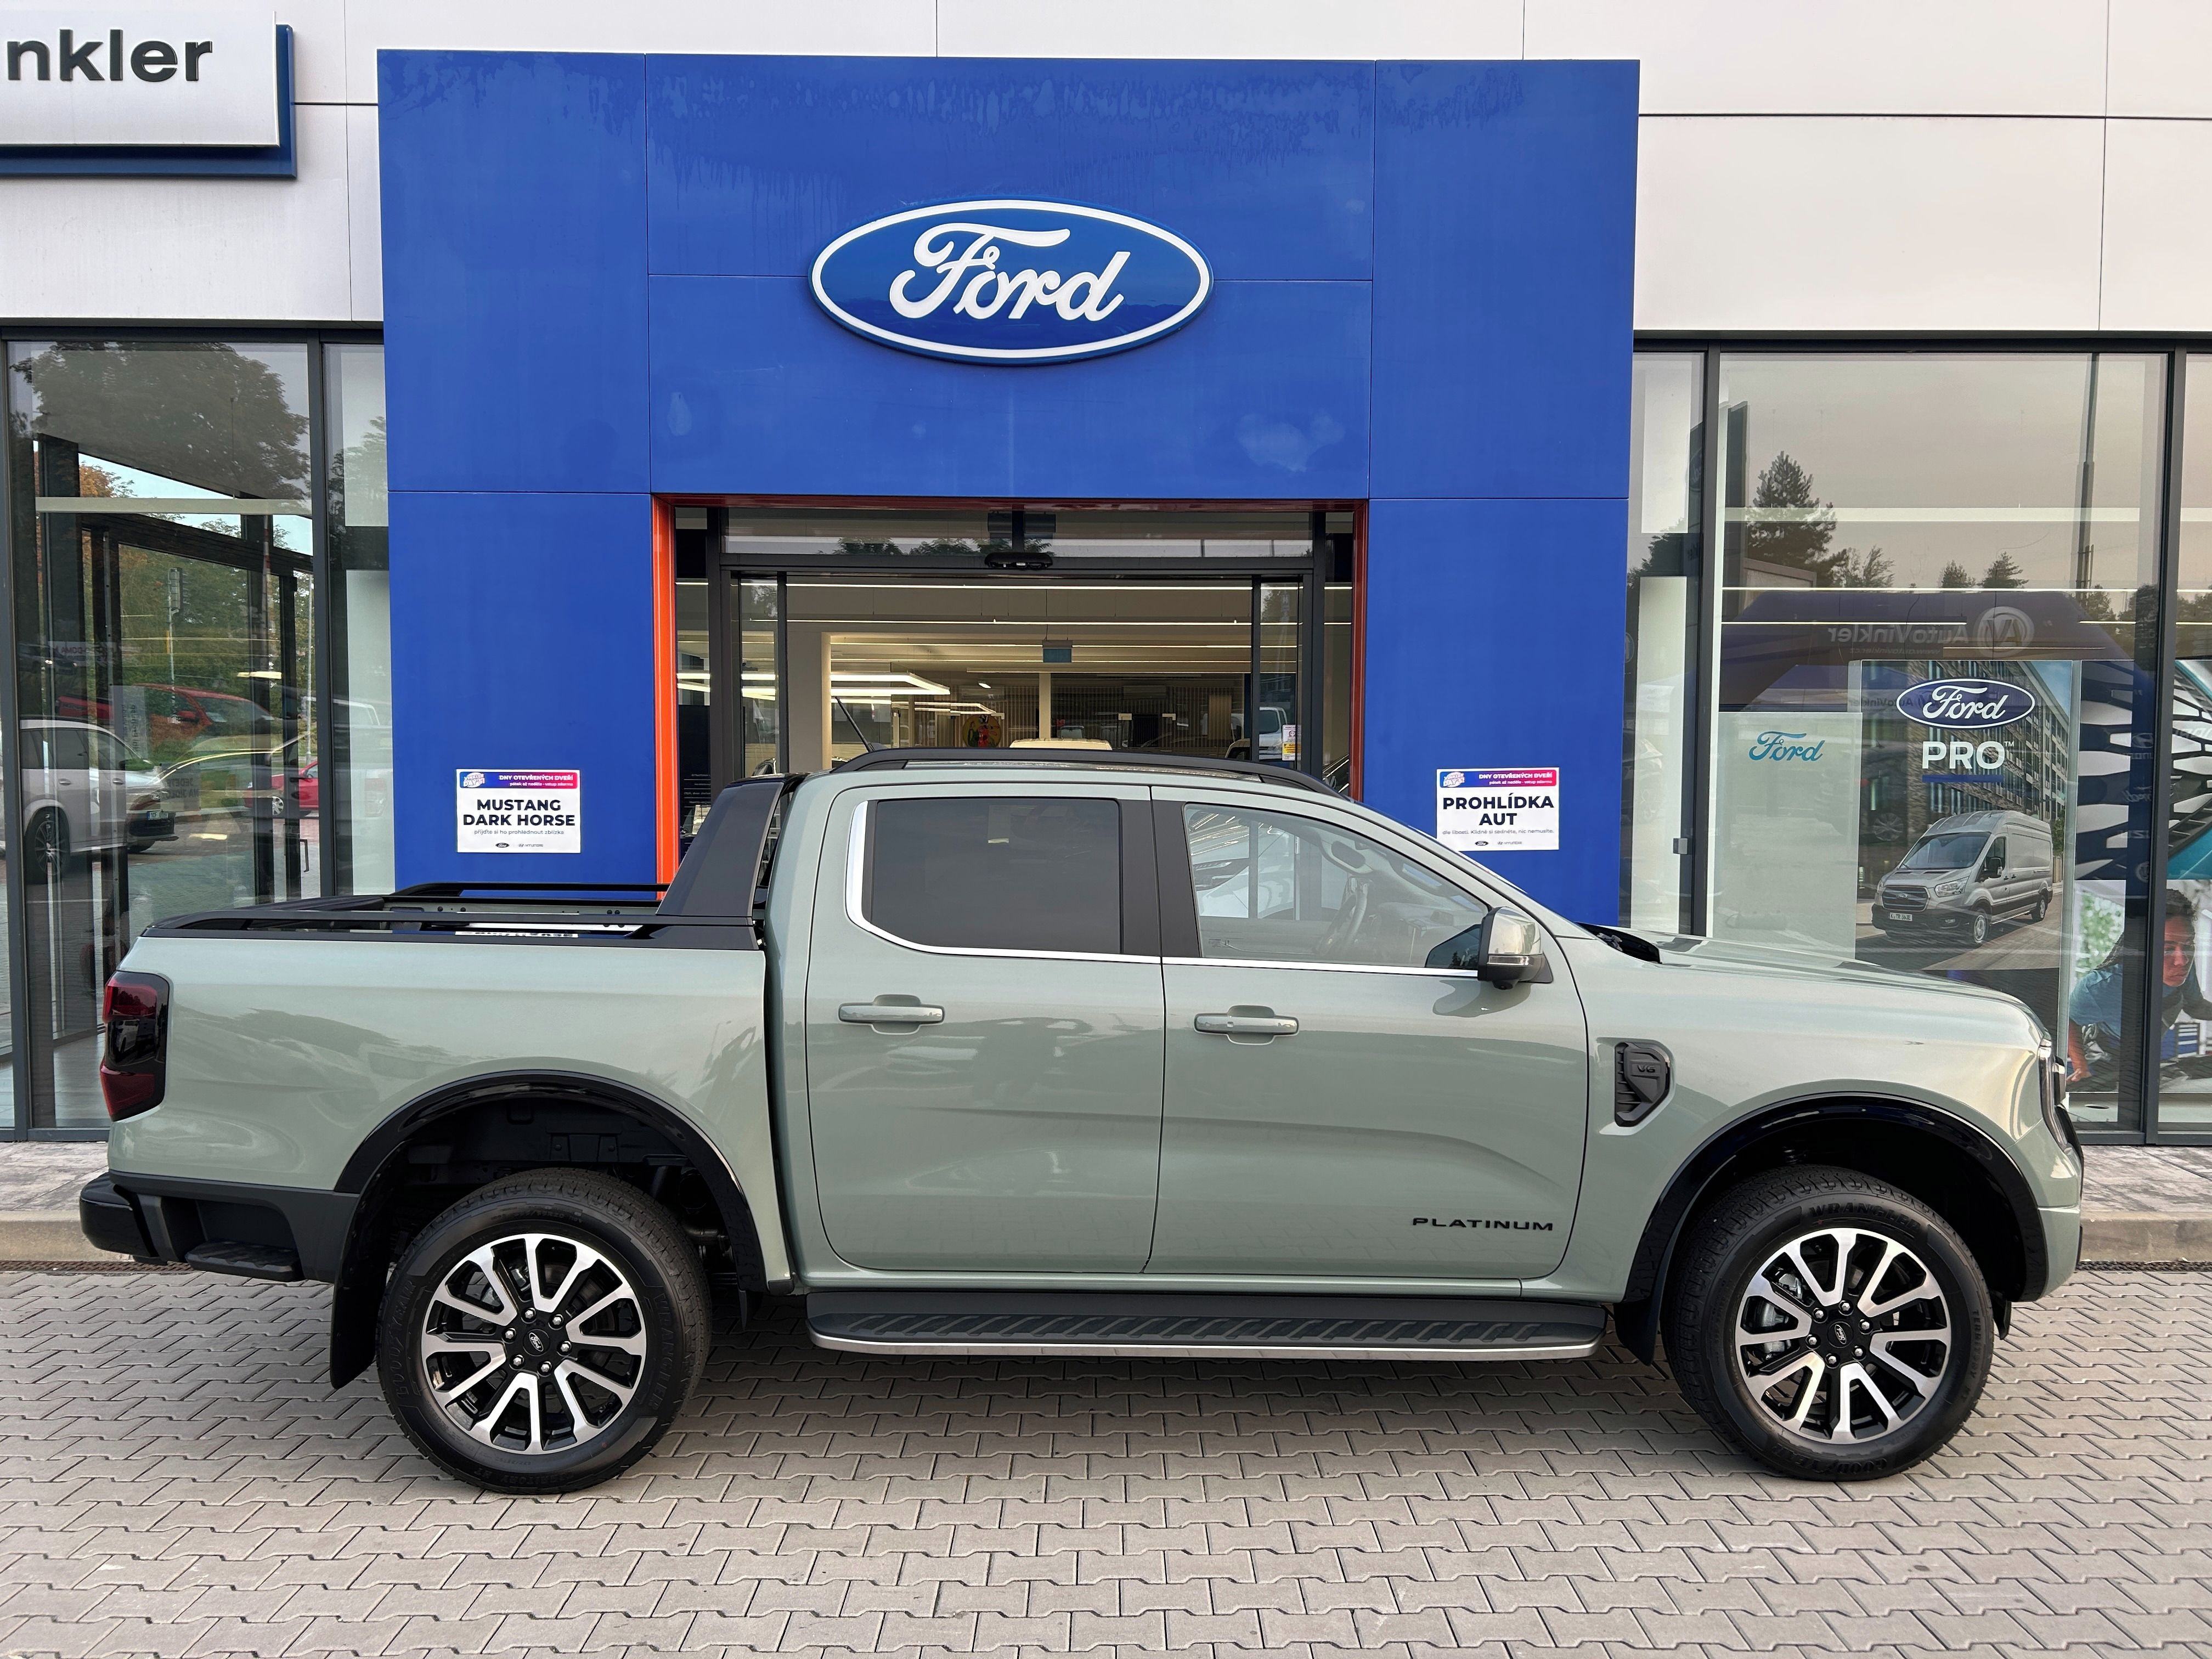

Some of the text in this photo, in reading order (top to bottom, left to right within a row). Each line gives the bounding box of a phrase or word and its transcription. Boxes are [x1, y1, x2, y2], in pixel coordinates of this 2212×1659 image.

[7, 29, 213, 82] nkler
[889, 222, 1131, 321] Ford
[1923, 685, 2008, 719] Ford
[1749, 731, 1825, 761] Ford
[1922, 741, 2005, 769] PRO
[477, 799, 561, 811] MUSTANG
[1443, 793, 1554, 810] PROHLÍDKA
[463, 814, 575, 826] DARK HORSE
[1479, 812, 1517, 826] AUT
[1637, 1064, 1656, 1073] V6
[1412, 1217, 1553, 1231] PLATINUM
[1810, 1202, 1921, 1229] WRANGLER
